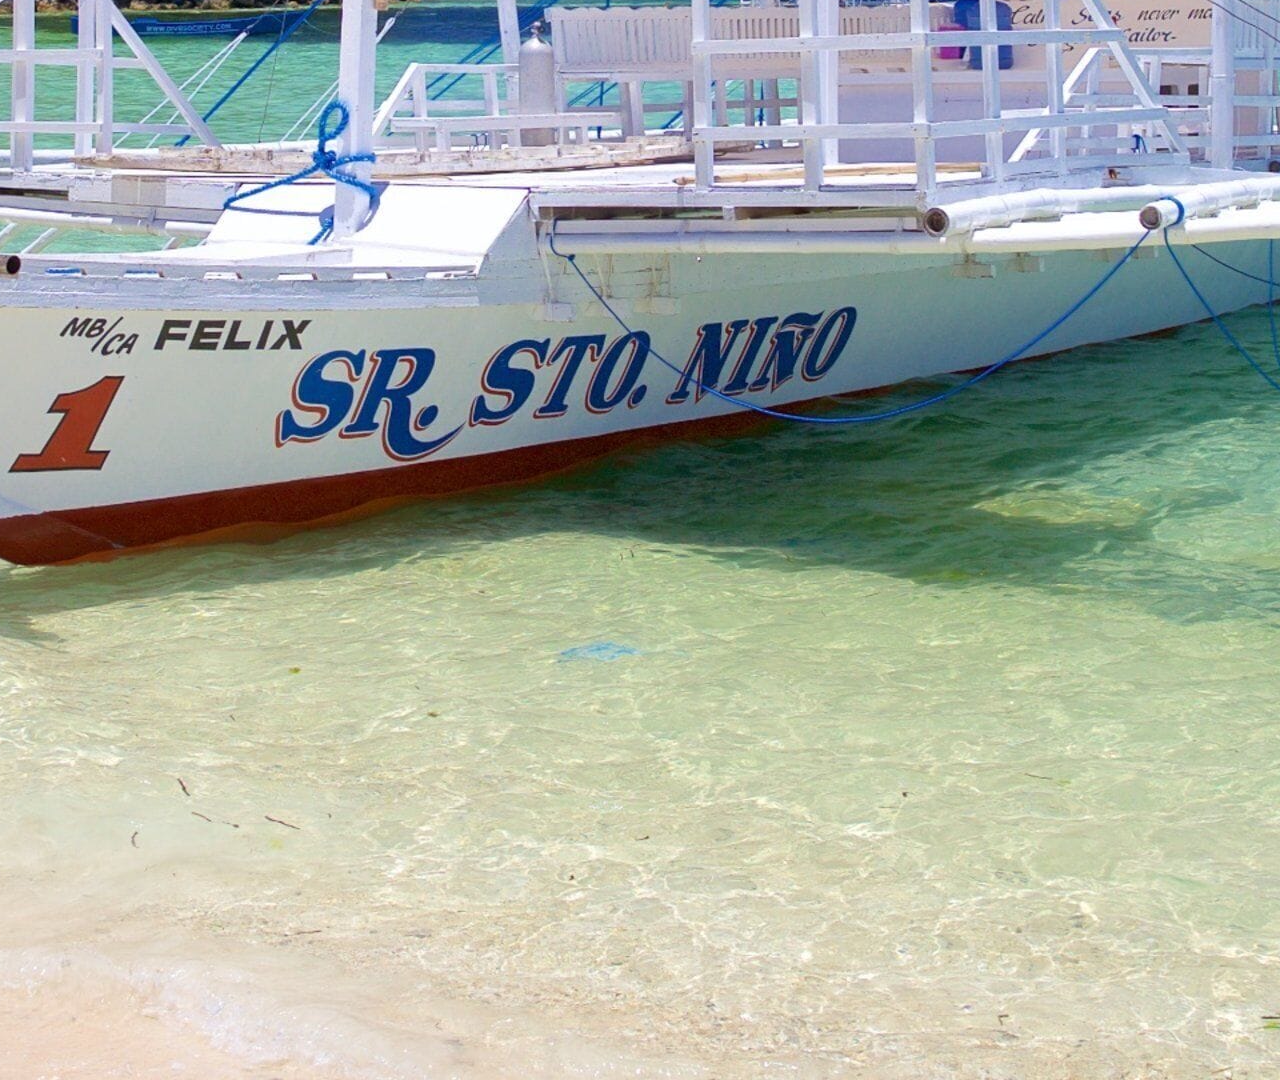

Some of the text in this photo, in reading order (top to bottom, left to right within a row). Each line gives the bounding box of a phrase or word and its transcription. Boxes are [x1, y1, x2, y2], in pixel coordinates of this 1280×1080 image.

[1137, 7, 1180, 21] never
[153, 319, 312, 350] FELIX
[275, 306, 857, 462] SR. STO. NIÑO
[8, 375, 125, 472] 1
